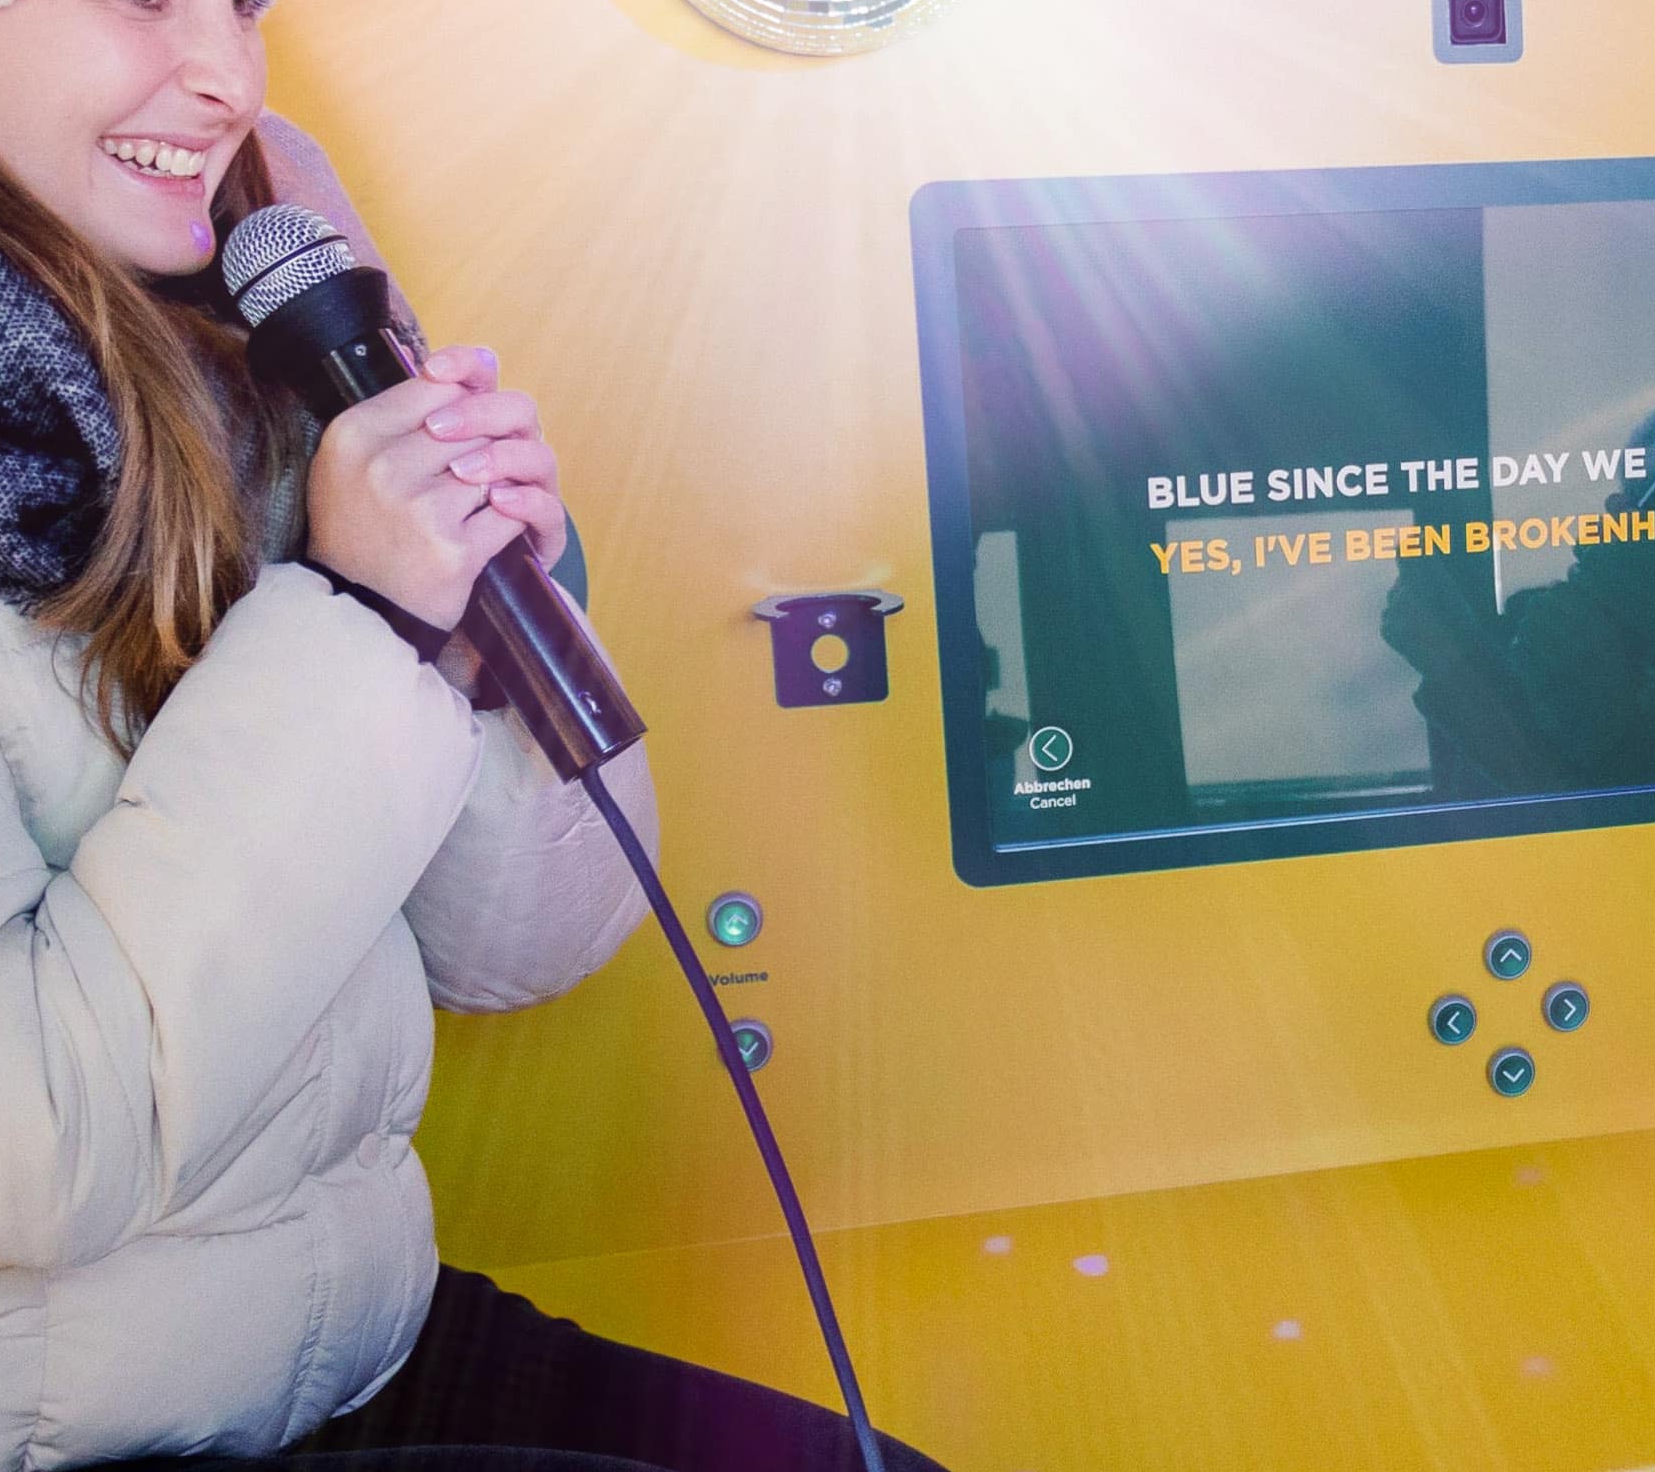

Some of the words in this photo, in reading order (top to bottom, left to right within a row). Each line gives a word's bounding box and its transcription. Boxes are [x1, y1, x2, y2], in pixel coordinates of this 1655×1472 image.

[1147, 471, 1256, 509] BLUE
[1267, 463, 1390, 502] SINCE
[1400, 457, 1480, 493] THE
[1492, 452, 1570, 487] DAY
[1581, 447, 1647, 482] WE
[1149, 538, 1242, 576] YES,
[1254, 532, 1333, 567] I'VE
[1345, 524, 1452, 561] BEEN
[1013, 777, 1092, 796] Abbrechen
[1029, 793, 1077, 810] Cancel
[708, 969, 770, 987] Volume
